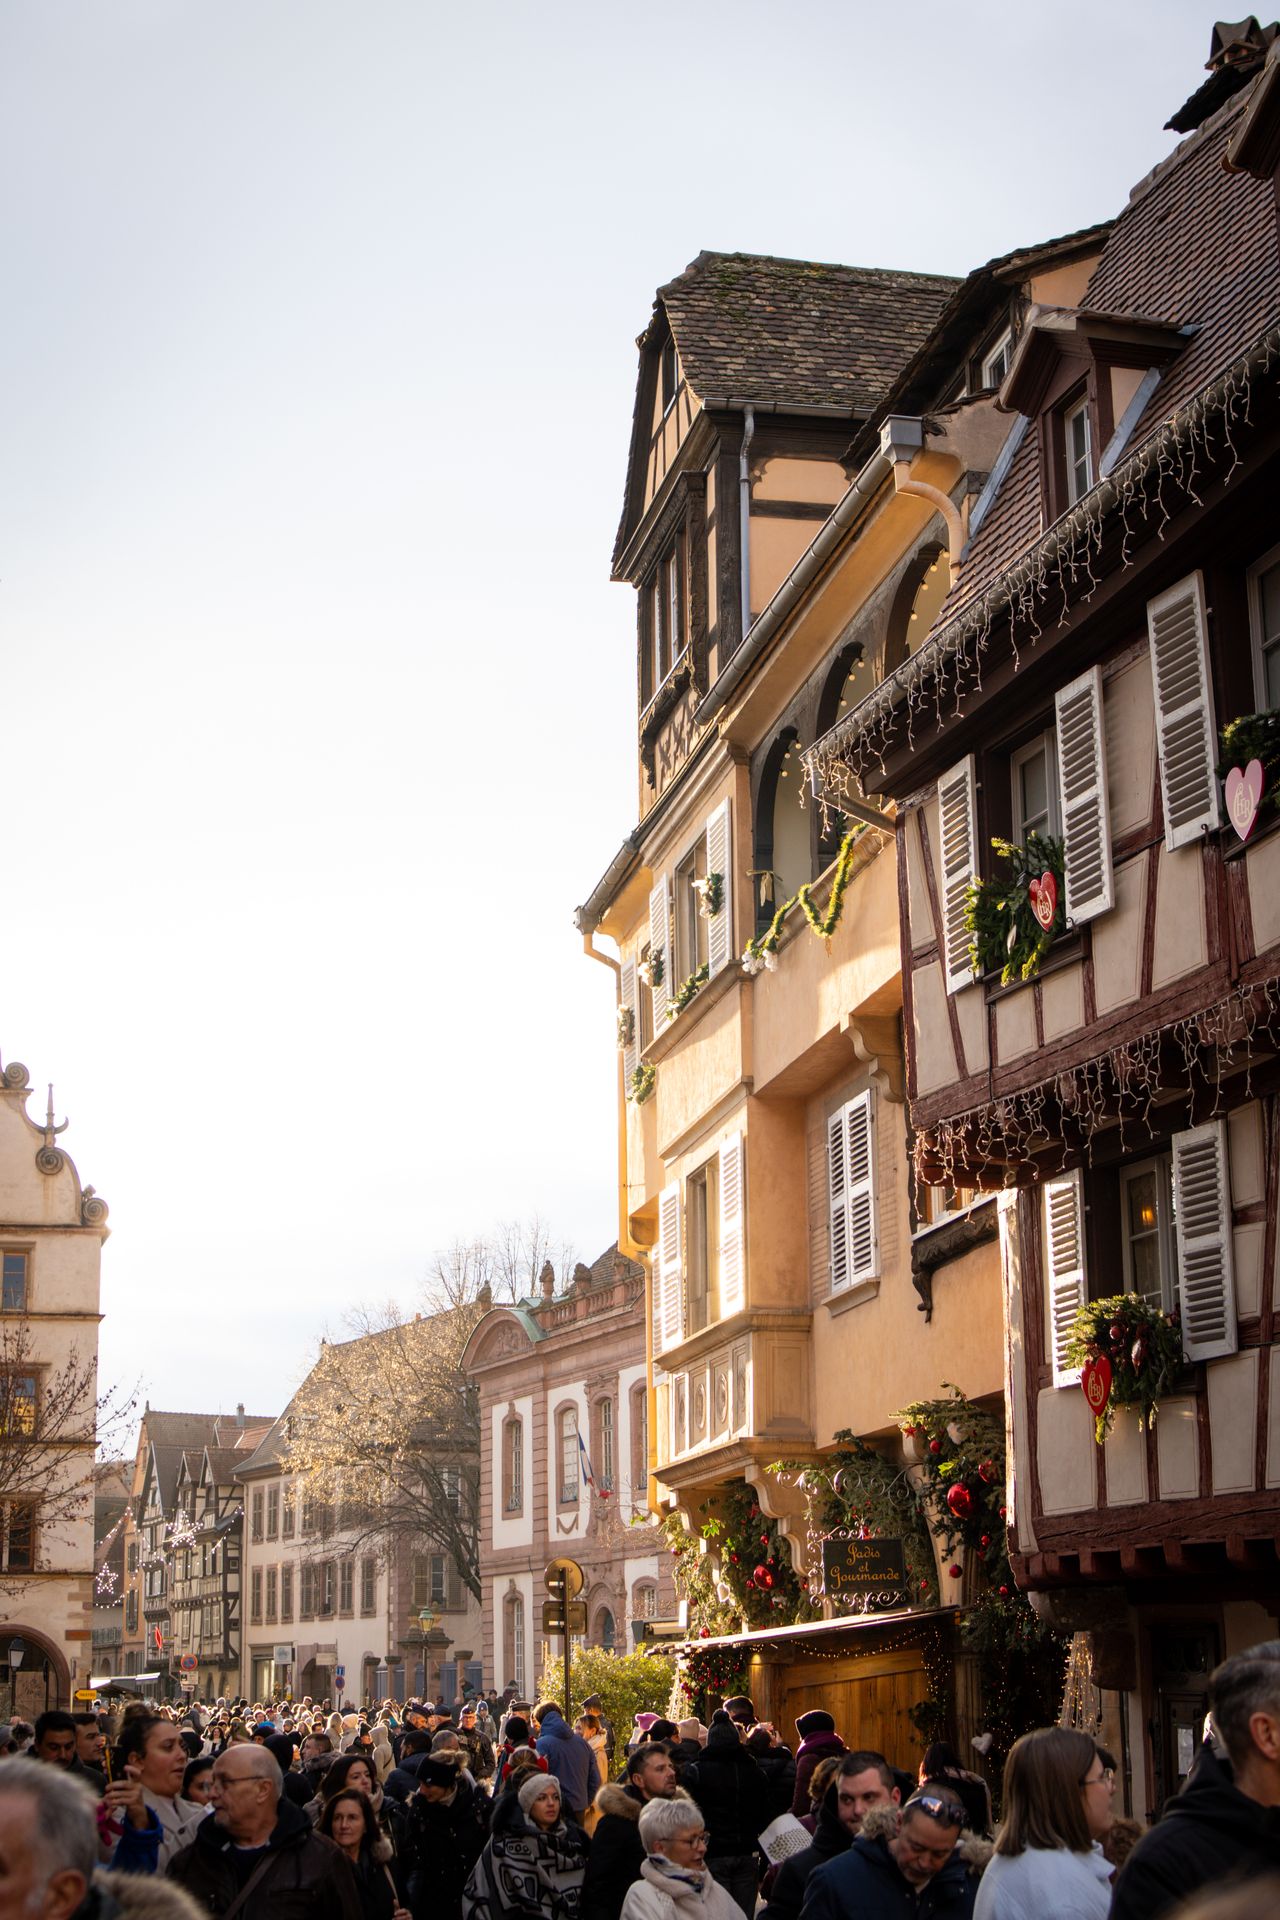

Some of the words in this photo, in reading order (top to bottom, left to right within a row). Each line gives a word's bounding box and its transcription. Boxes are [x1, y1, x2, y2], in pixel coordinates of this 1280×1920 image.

[846, 1542, 880, 1566] Jadis
[830, 1565, 900, 1590] Gourmande
[858, 1561, 870, 1573] et
